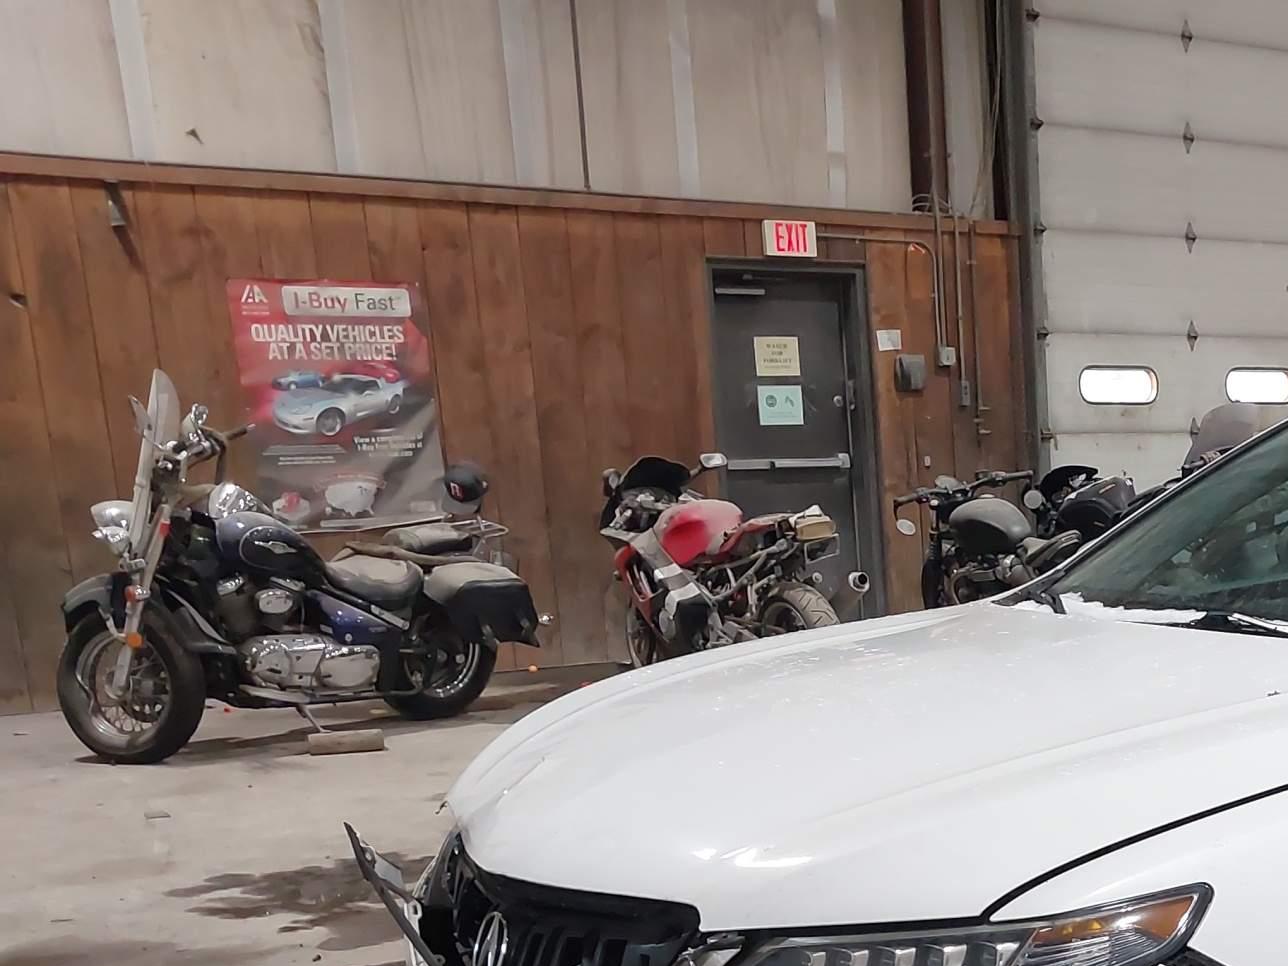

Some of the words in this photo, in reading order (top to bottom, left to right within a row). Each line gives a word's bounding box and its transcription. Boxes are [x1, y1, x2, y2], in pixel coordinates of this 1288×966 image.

[775, 222, 808, 253] EXIT
[293, 291, 348, 313] I-Buy
[354, 292, 397, 312] Fast
[251, 323, 324, 343] QUALITY
[325, 324, 405, 344] VEHICLES
[268, 342, 291, 361] AT
[295, 342, 308, 361] A
[310, 342, 342, 361] SET
[344, 343, 397, 361] PRICE!
